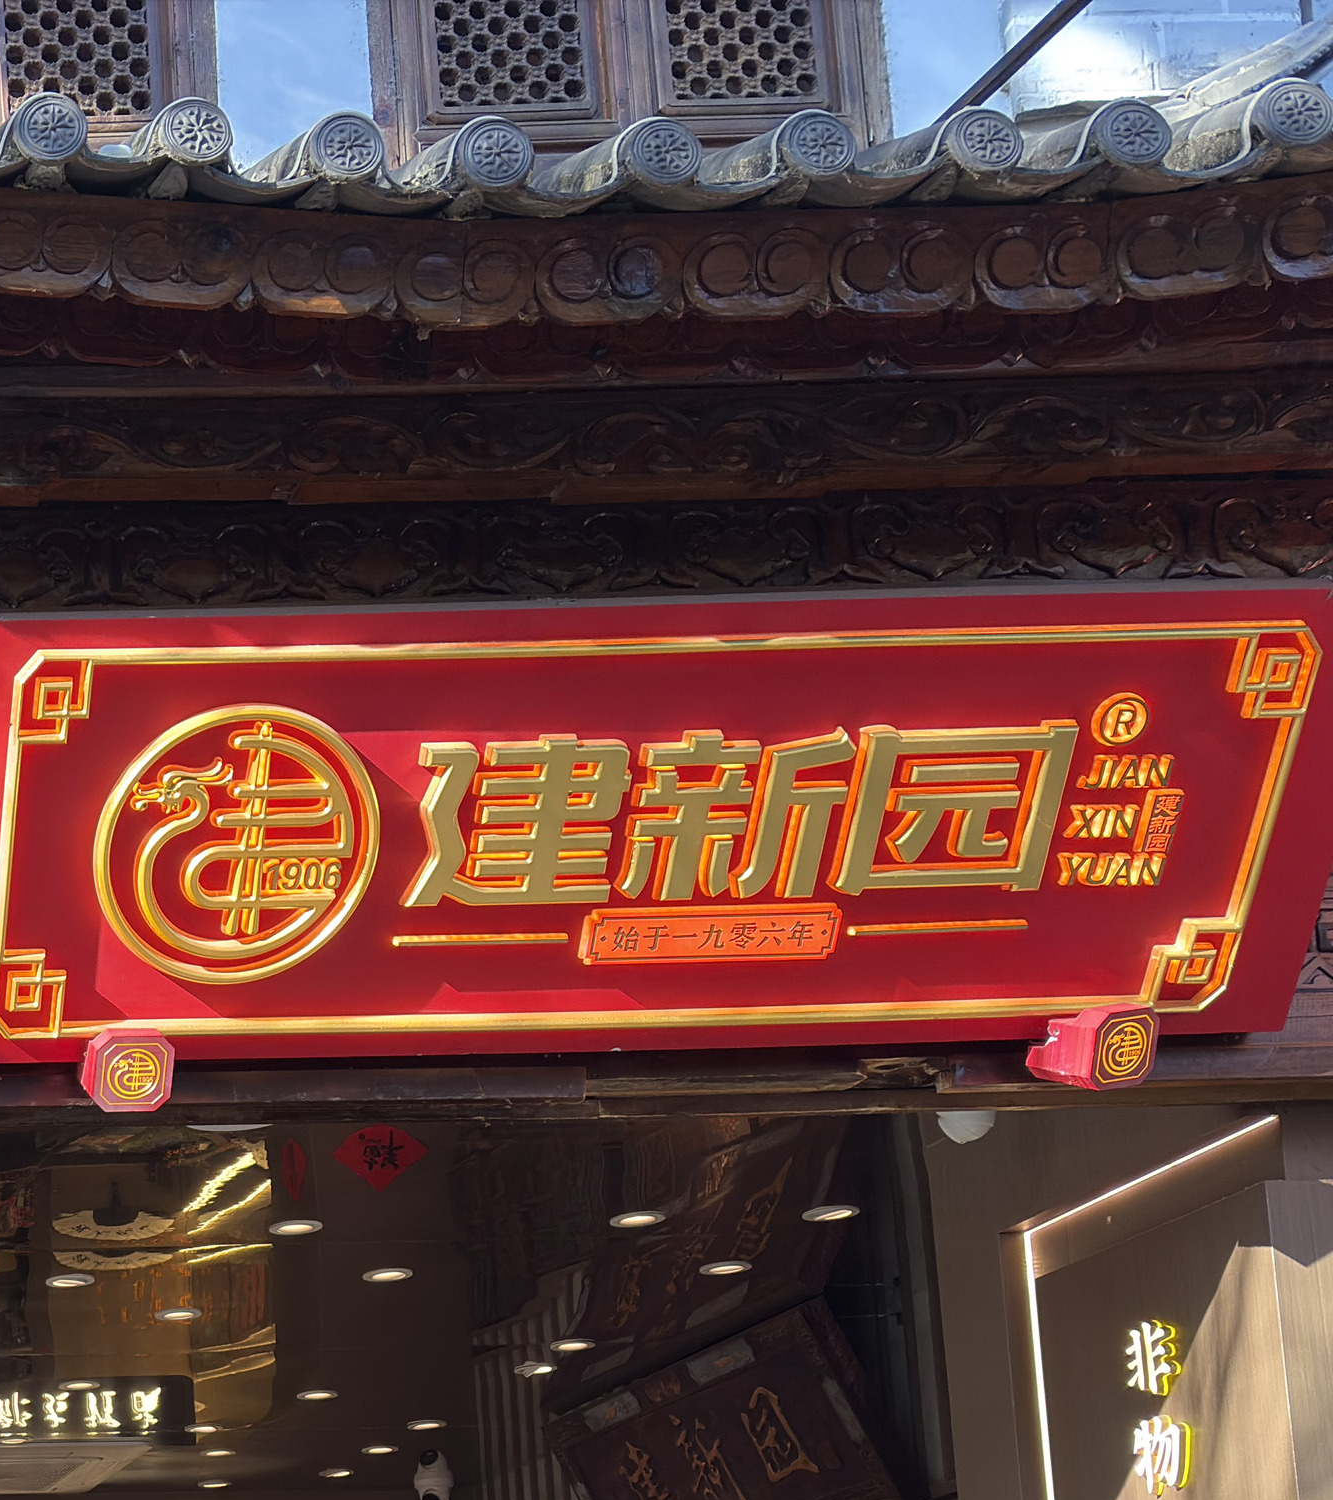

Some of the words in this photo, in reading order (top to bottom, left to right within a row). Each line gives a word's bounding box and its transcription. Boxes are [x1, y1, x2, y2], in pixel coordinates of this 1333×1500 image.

[1076, 753, 1176, 789] JIAN
[403, 718, 1079, 908] 建新园
[1062, 803, 1134, 840] XIN
[265, 858, 343, 892] 1906
[1055, 850, 1165, 887] YUAN
[612, 920, 817, 953] 始于一九零六年
